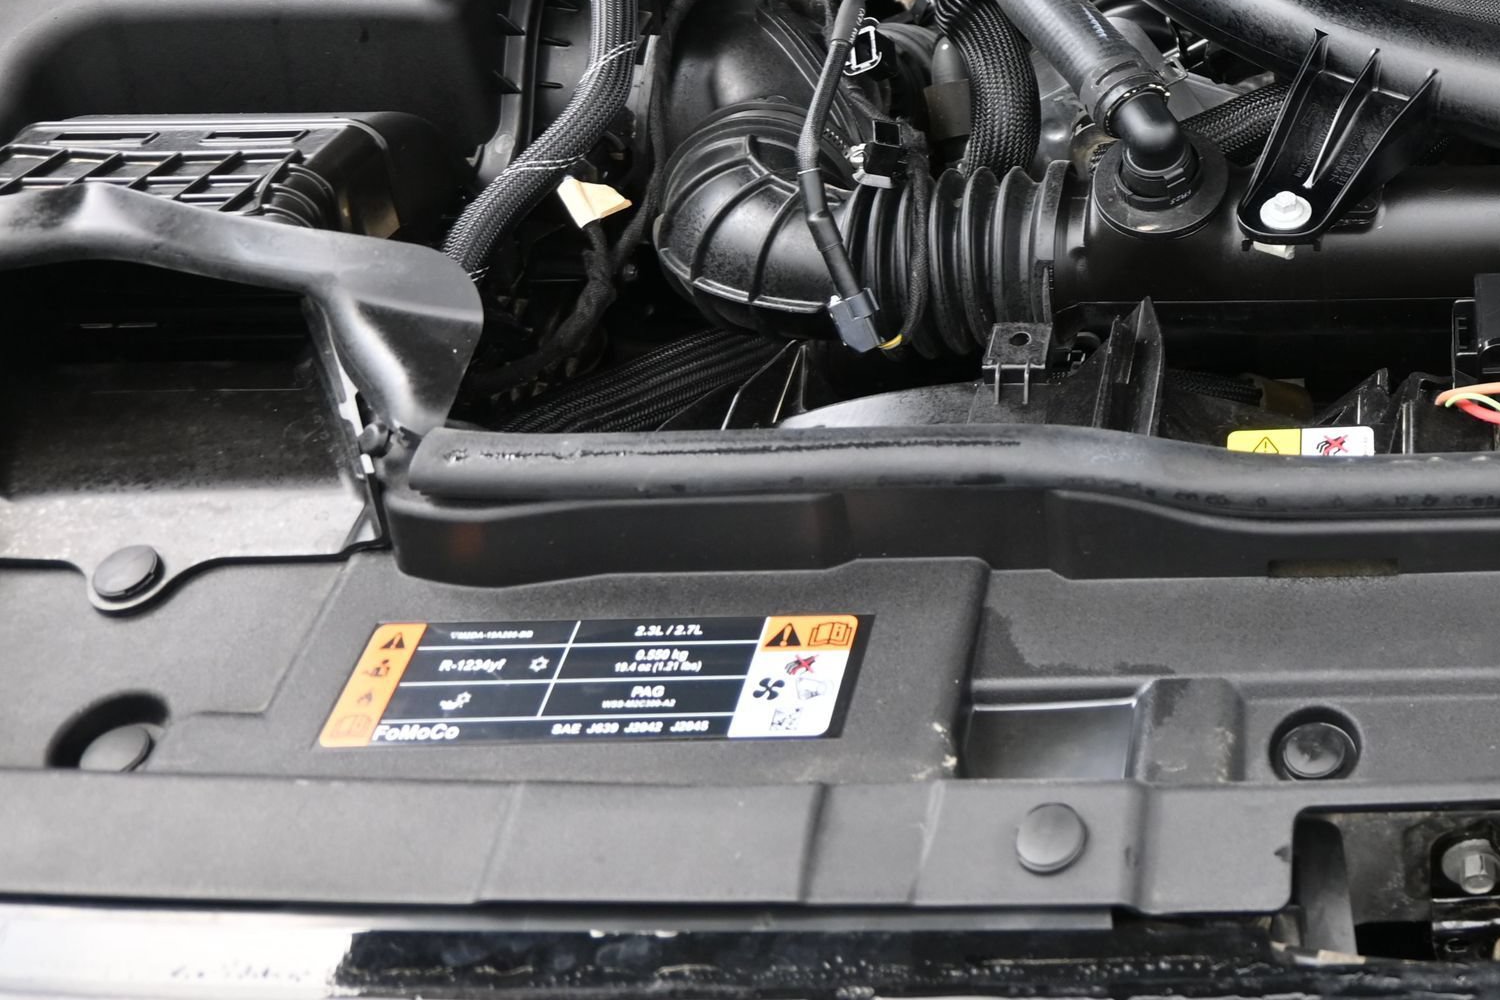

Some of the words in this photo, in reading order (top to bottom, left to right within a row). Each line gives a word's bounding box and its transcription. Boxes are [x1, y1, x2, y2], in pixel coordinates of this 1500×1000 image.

[634, 626, 664, 636] 2.3L
[674, 624, 703, 636] 2.7L
[671, 648, 690, 662] kg
[438, 658, 507, 672] R-1234yf
[630, 685, 666, 698] PAG
[372, 723, 460, 741] FoMoCo
[551, 723, 582, 735] SAE
[586, 722, 620, 734] J639
